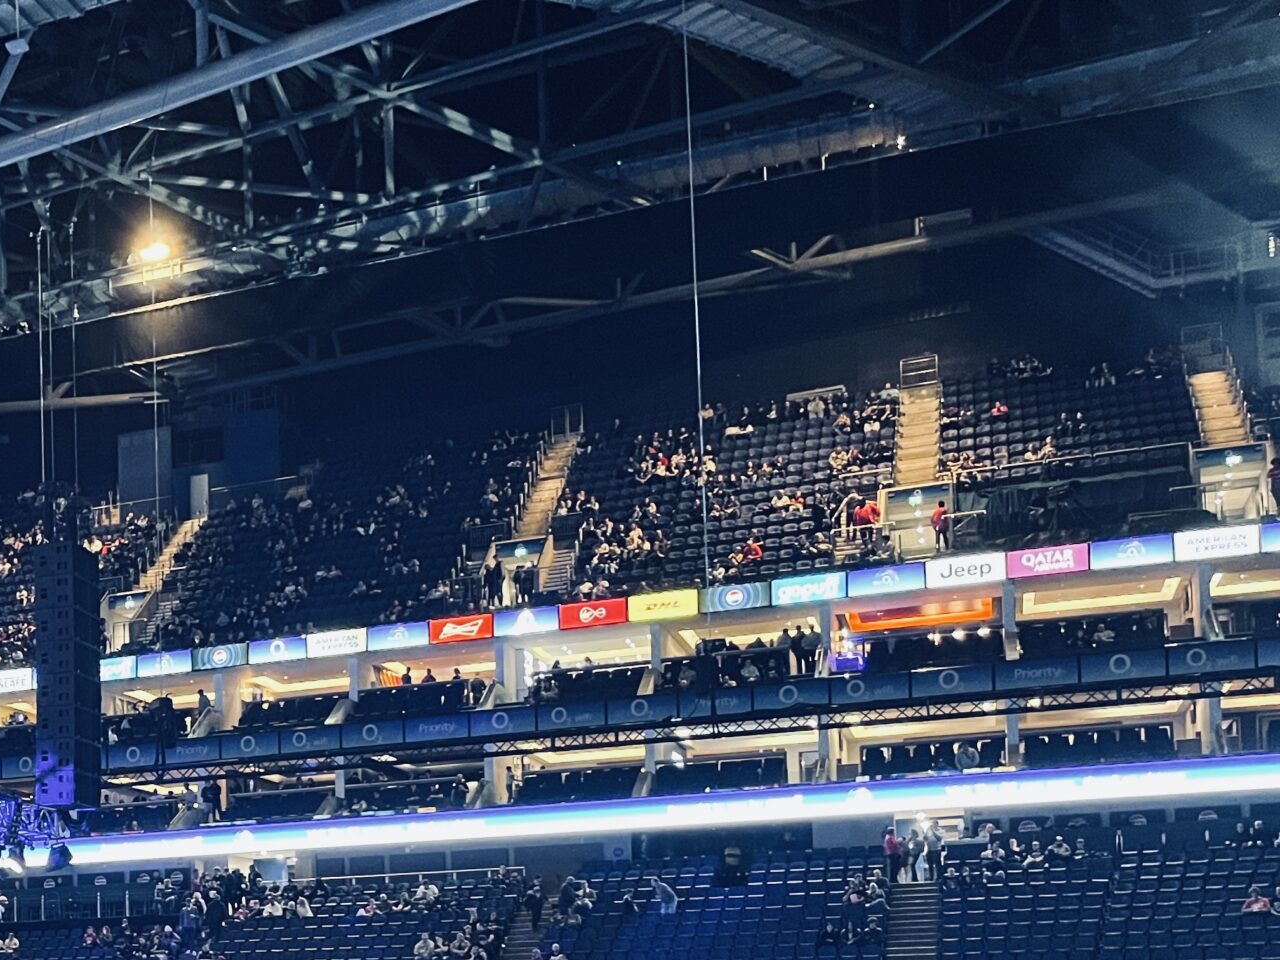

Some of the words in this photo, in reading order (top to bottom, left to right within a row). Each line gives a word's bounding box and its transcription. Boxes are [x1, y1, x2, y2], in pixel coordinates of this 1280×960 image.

[1187, 533, 1247, 545] AMERICAN
[1195, 542, 1248, 552] EXPRESS
[1021, 549, 1074, 567] QATAR
[940, 563, 992, 579] Jeep
[778, 576, 841, 603] gopuff
[645, 601, 680, 611] DHL
[1014, 667, 1060, 680] Priority
[419, 722, 456, 736] Priority
[176, 744, 208, 758] Priority
